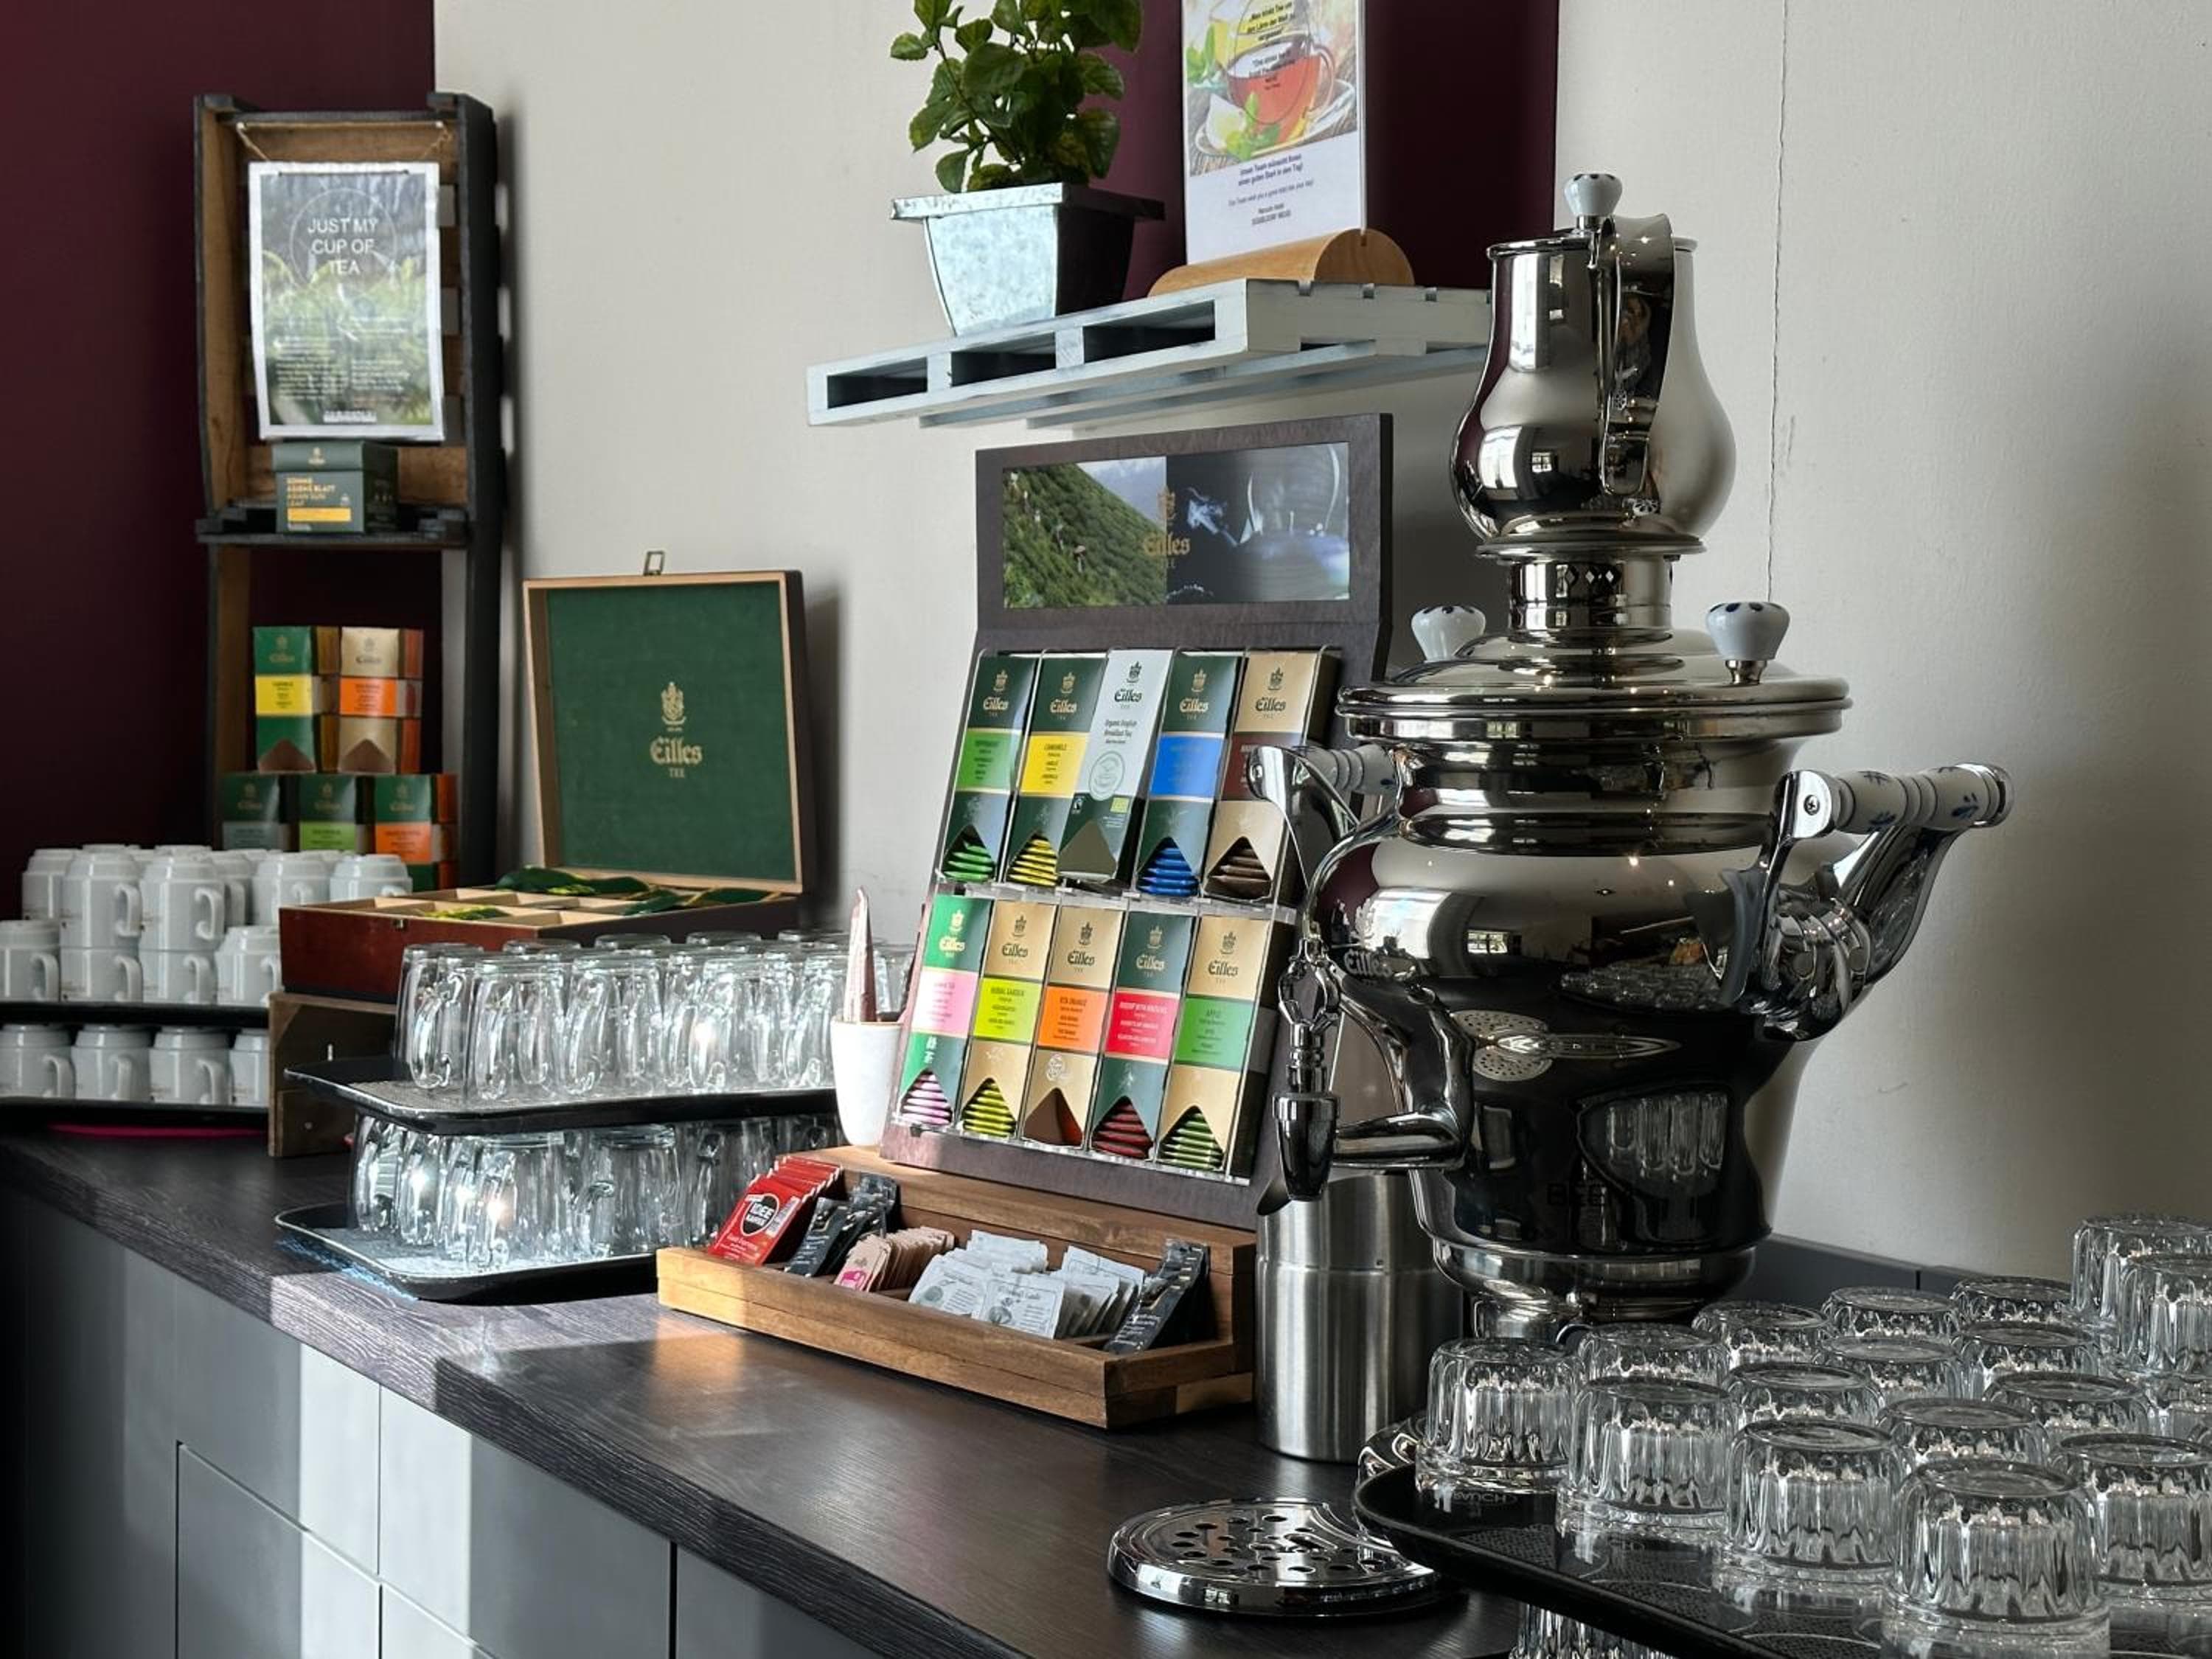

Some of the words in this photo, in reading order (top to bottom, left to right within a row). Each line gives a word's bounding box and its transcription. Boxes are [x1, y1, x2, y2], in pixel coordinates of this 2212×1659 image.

[307, 218, 350, 233] JUST
[353, 218, 379, 233] MY
[312, 238, 347, 254] CUP
[351, 238, 375, 254] OF
[327, 260, 361, 275] TEA
[1143, 531, 1191, 556] Eilles
[983, 696, 1009, 711] Eilles
[1114, 688, 1142, 703] Eilles
[1050, 698, 1077, 714] Eilles
[1180, 697, 1209, 713] Eilles
[1255, 697, 1286, 712] Eilles
[650, 735, 703, 765] Eilles
[1001, 942, 1029, 958] Eilles
[1068, 950, 1095, 966] Eilles
[1135, 953, 1164, 972] Eilles
[1207, 959, 1239, 977] Eilles
[1343, 948, 1393, 978] Eilles
[749, 1201, 775, 1220] IDEE
